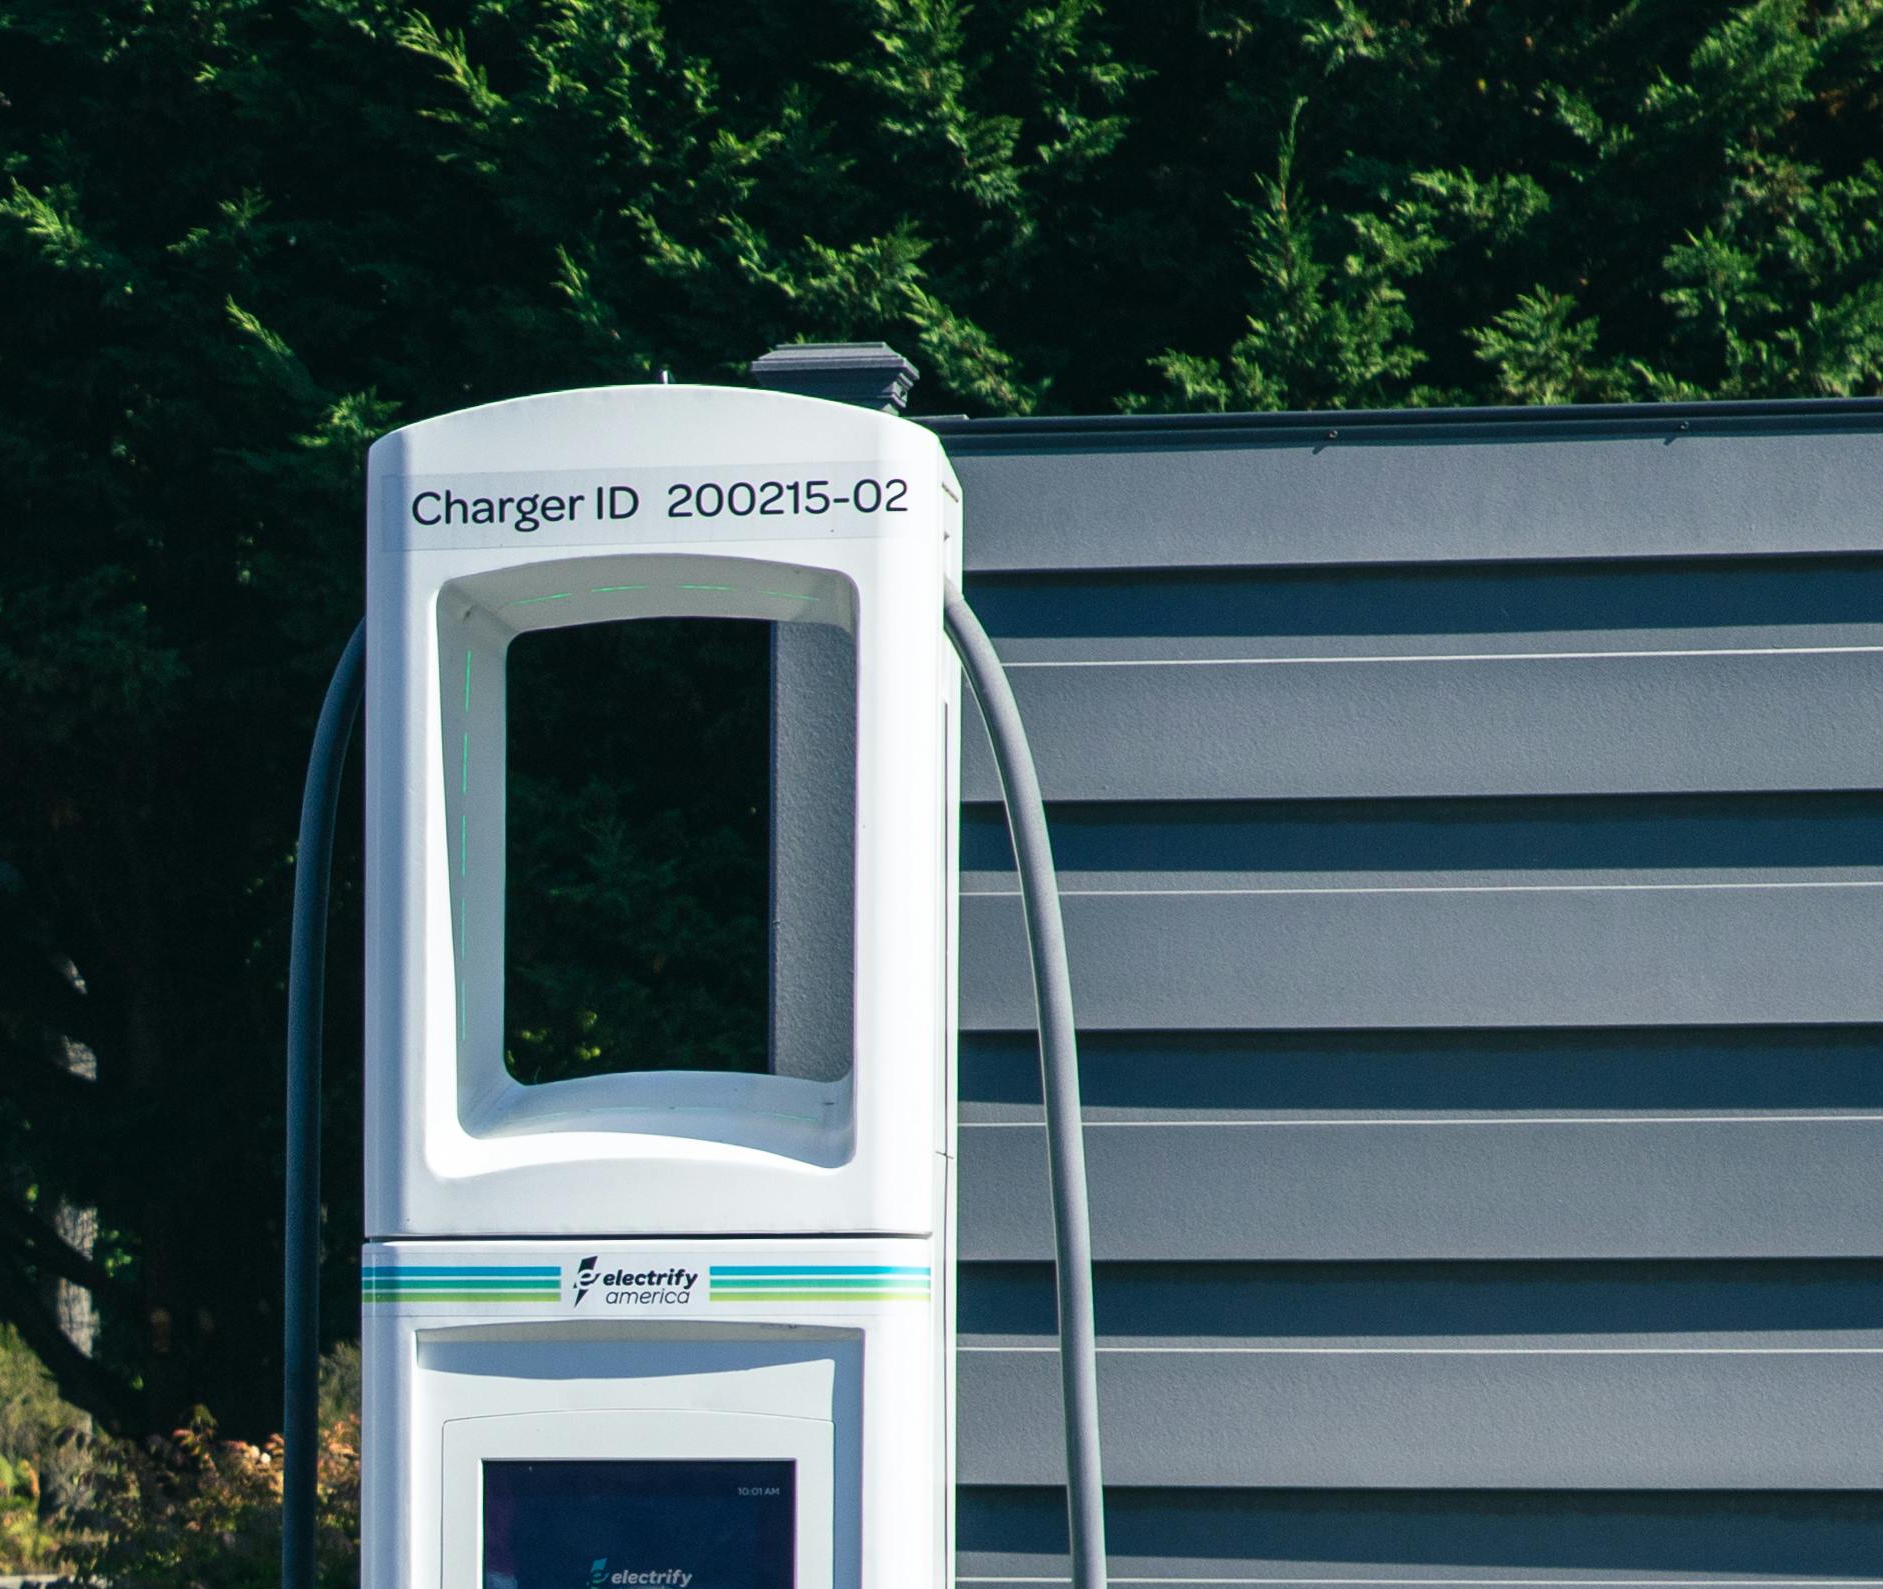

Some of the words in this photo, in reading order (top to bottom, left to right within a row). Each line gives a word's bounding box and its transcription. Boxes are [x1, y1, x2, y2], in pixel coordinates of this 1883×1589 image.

[411, 488, 585, 532] Charger
[596, 486, 639, 520] ID
[667, 478, 909, 518] 200215-02
[603, 1268, 699, 1290] electrify
[605, 1288, 691, 1304] america
[611, 1568, 693, 1588] electrify
